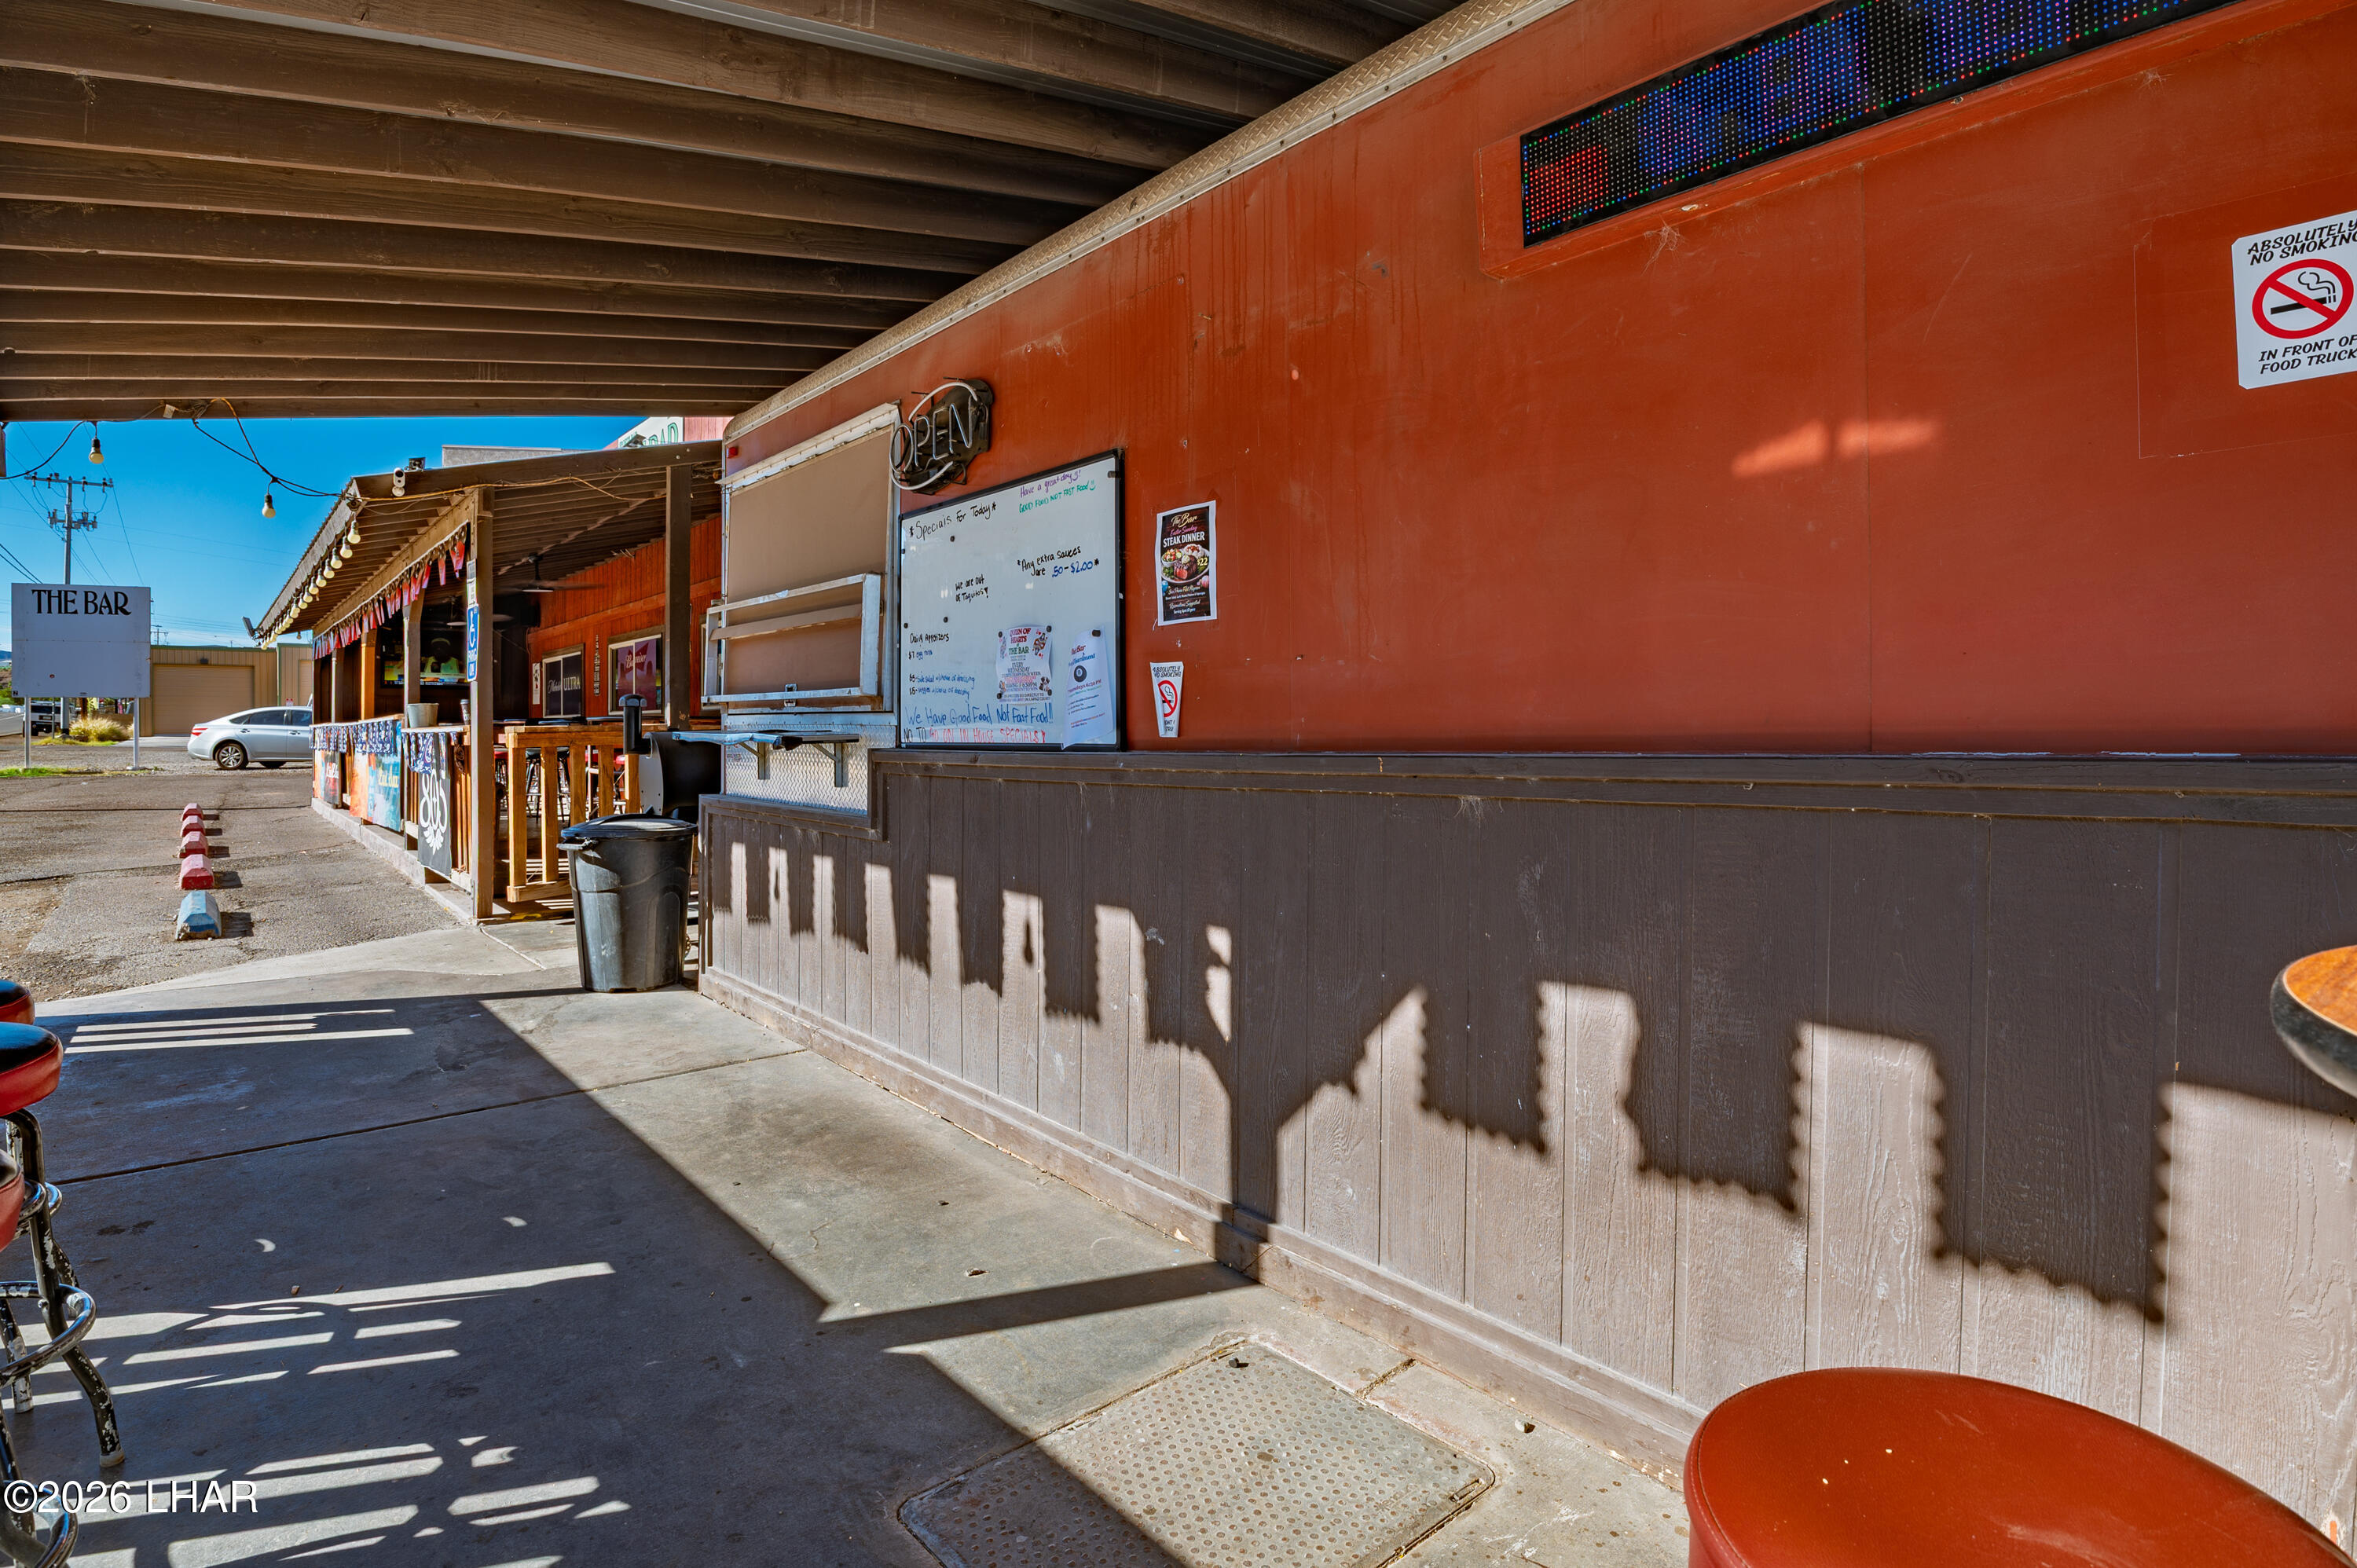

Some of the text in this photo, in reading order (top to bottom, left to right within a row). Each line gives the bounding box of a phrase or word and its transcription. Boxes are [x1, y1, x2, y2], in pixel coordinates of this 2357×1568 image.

[2248, 220, 2357, 255] ABSOLUTELY
[2250, 251, 2274, 266] NO
[2259, 335, 2357, 362] IN FRONT OF
[2260, 349, 2357, 375] FOOD TRUCK
[889, 395, 973, 474] OPEN
[1020, 485, 1034, 498] Have
[1044, 476, 1060, 493] great
[1050, 492, 1062, 502] NOT
[1178, 512, 1197, 527] Bar
[1163, 531, 1205, 548] STEAK DINNER
[1036, 554, 1054, 565] extra
[1197, 557, 1208, 566] $22
[31, 589, 132, 616] THE BAR
[563, 676, 581, 691] ULTRA
[905, 706, 922, 725] We
[926, 706, 947, 725] Have
[950, 703, 972, 727] Good
[972, 703, 992, 725] Food
[996, 703, 1010, 723] Not
[1012, 705, 1028, 723] Fast
[904, 727, 913, 742] NO
[916, 727, 927, 742] TO
[420, 769, 448, 833] 805
